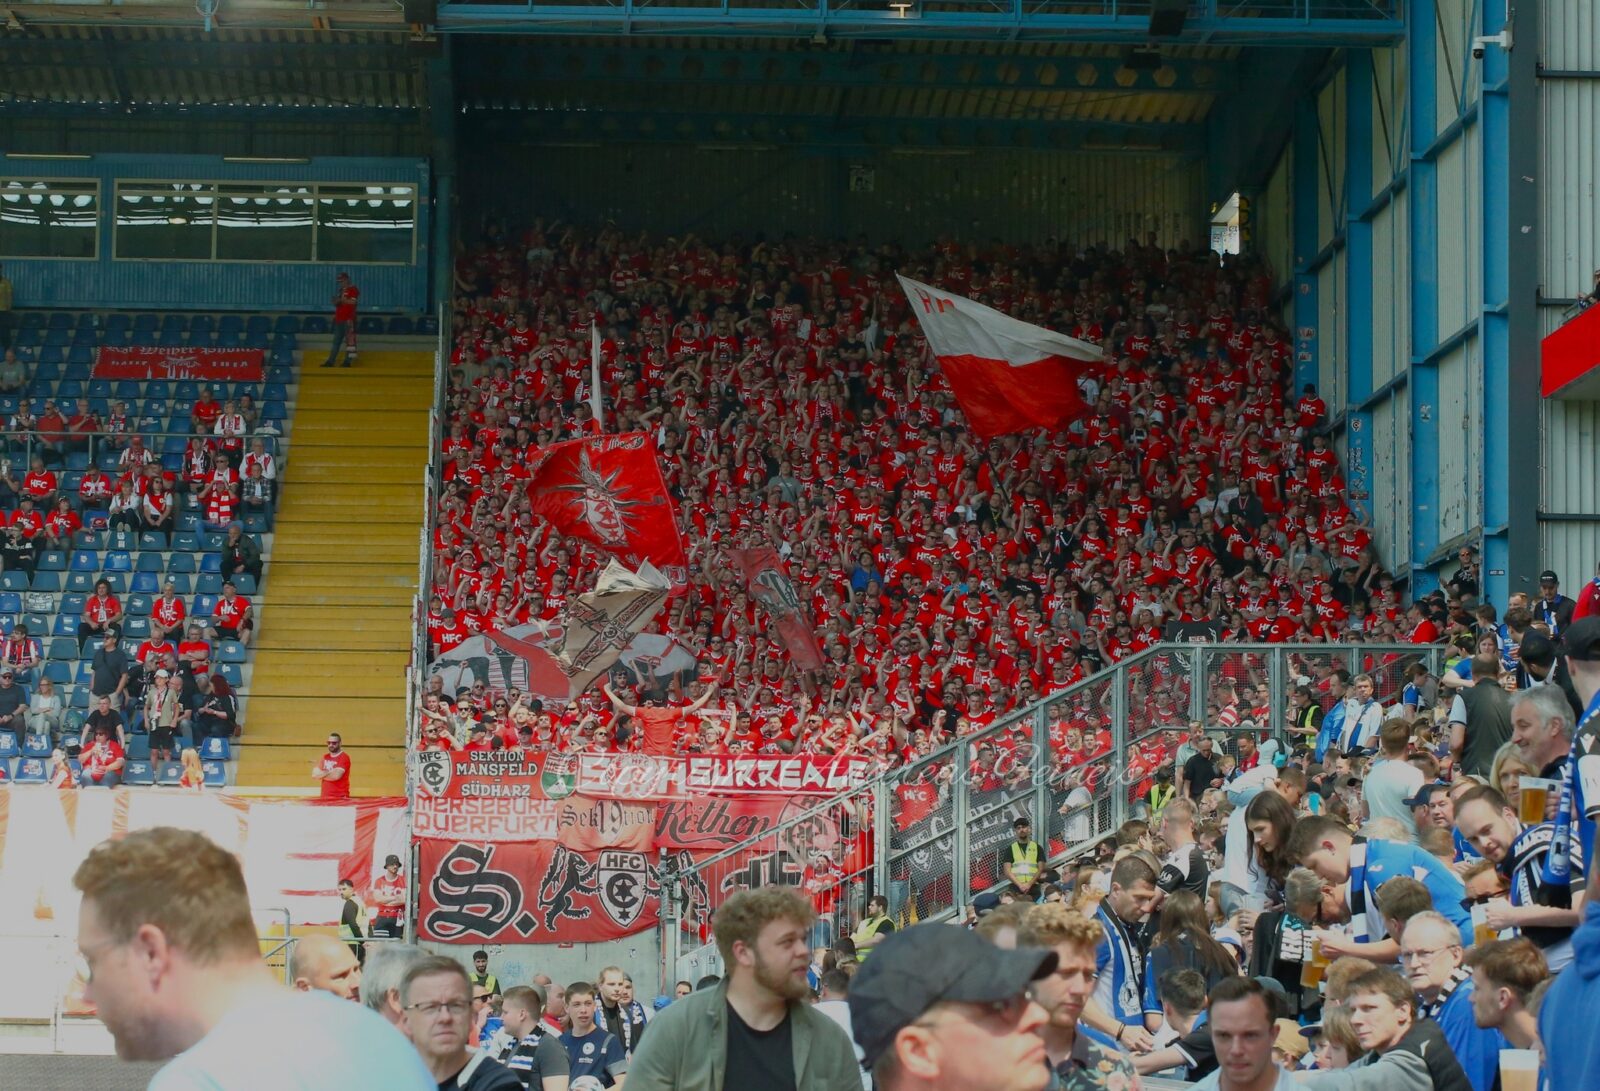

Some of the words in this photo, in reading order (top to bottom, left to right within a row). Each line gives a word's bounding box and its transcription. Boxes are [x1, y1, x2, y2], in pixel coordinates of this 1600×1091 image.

[680, 346, 695, 354] HFC
[1132, 343, 1150, 351] HFC
[566, 368, 580, 379] HFC
[1154, 400, 1166, 408] FC
[1198, 396, 1216, 405] HFC
[1300, 403, 1316, 414] HFC
[864, 429, 876, 439] FC
[1248, 455, 1260, 463] HF
[939, 463, 956, 472] HFC
[1256, 472, 1272, 481] HFC
[31, 479, 47, 488] HFC
[913, 490, 931, 499] HFC
[1132, 505, 1144, 514] FC
[1230, 533, 1242, 542] HF
[1343, 545, 1360, 554] HFC
[546, 599, 566, 608] HFC
[429, 619, 441, 628] HF
[464, 617, 481, 629] HFC
[966, 616, 985, 629] HFC
[442, 633, 462, 642] HFC
[1058, 637, 1070, 645] FC
[955, 655, 972, 667] HFC
[982, 676, 992, 685] FC
[970, 721, 984, 730] FC
[742, 741, 754, 751] FC
[419, 751, 442, 763] HFC
[470, 751, 525, 761] SEKTION
[456, 763, 538, 776] MANSFELD
[690, 757, 868, 789] SURREALE
[461, 780, 531, 797] SÜDHARZ
[904, 790, 928, 801] HFC
[606, 854, 640, 869] HFC
